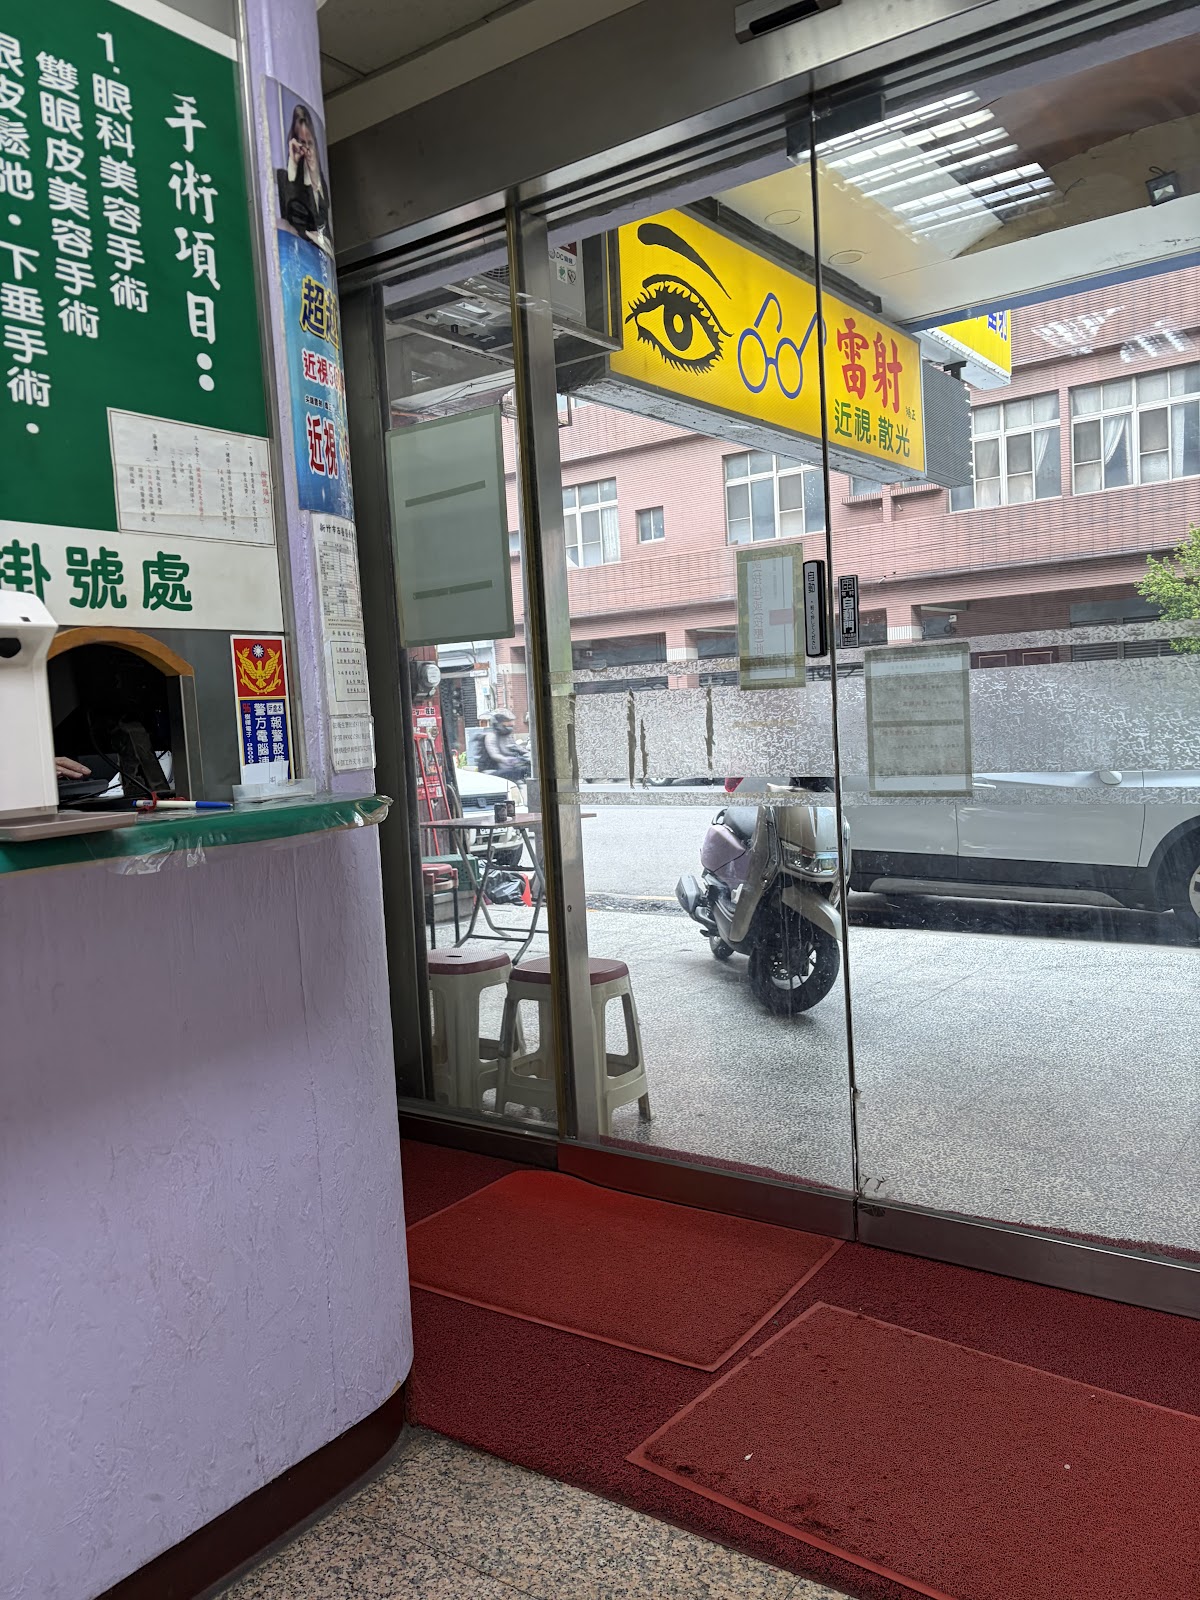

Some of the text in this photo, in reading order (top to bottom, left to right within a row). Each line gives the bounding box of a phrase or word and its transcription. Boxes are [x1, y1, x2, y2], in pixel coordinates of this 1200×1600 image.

[36, 51, 101, 339] 雙眼皮美容手術
[92, 32, 149, 313] 1.眼科美容手術
[837, 318, 903, 414] 雷射
[306, 414, 338, 478] 近視
[0, 539, 194, 611] 掛號處
[842, 597, 855, 633] 自動門
